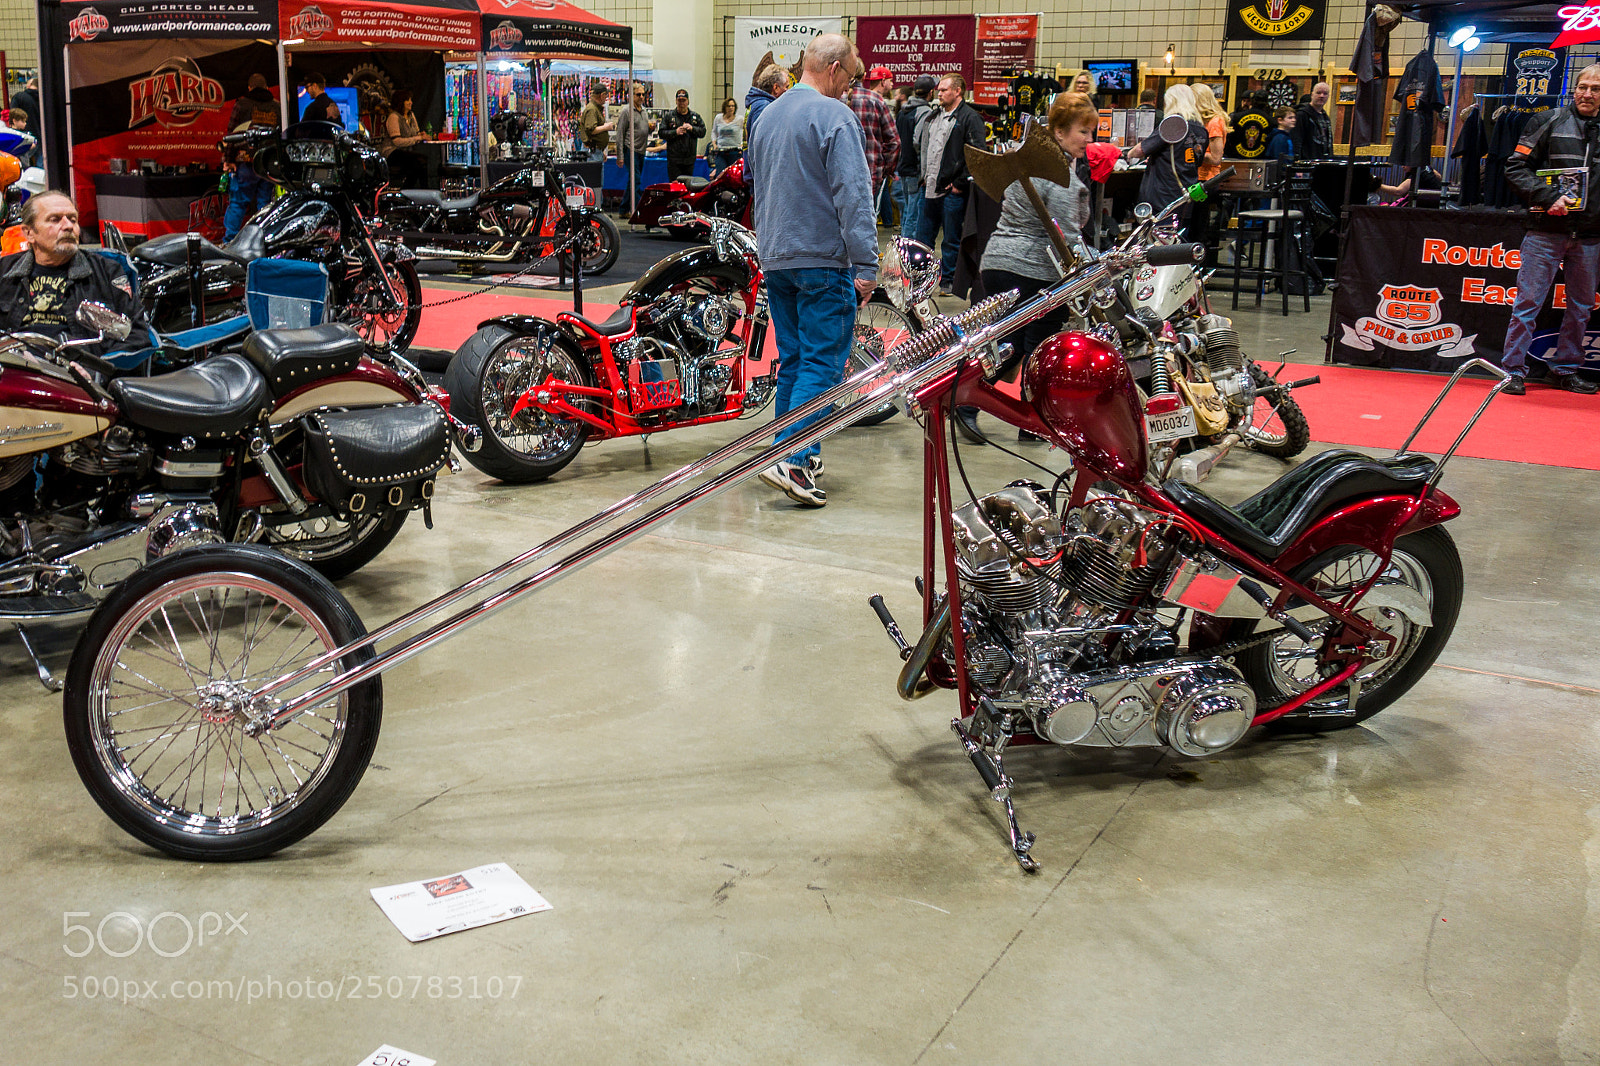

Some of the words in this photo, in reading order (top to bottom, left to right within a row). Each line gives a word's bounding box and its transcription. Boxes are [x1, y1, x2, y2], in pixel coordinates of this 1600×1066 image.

[113, 20, 271, 34] www.wardperformance.com
[290, 14, 334, 39] WARD
[363, 11, 404, 19] PORTING
[441, 18, 472, 27] TUNING
[380, 20, 445, 32] PERFORMANCE
[1247, 12, 1270, 31] JESUS
[1284, 11, 1306, 30] LORD
[69, 14, 109, 41] WARD
[556, 25, 589, 33] PORTED
[593, 30, 620, 38] HEADS
[750, 24, 823, 38] MINNESOTA
[886, 24, 946, 40] ABATE
[337, 27, 476, 45] www.wardperformance.com
[490, 25, 523, 50] WARD
[767, 39, 807, 48] AMERICAN
[525, 38, 630, 55] www.wardperformance.com
[872, 44, 918, 52] AMERICAN
[924, 43, 956, 52] BIKERS
[908, 53, 923, 62] FOR
[920, 62, 962, 72] TRAINING
[1258, 69, 1283, 80] 219
[1517, 77, 1549, 95] 219
[128, 72, 225, 129] WARD
[1421, 238, 1522, 270] Route
[1390, 289, 1432, 302] ROUTE
[1386, 302, 1431, 321] 65
[1363, 321, 1394, 340] PUB
[1399, 332, 1409, 344] &
[1412, 327, 1454, 344] GRUB
[1149, 415, 1190, 433] MD6032
